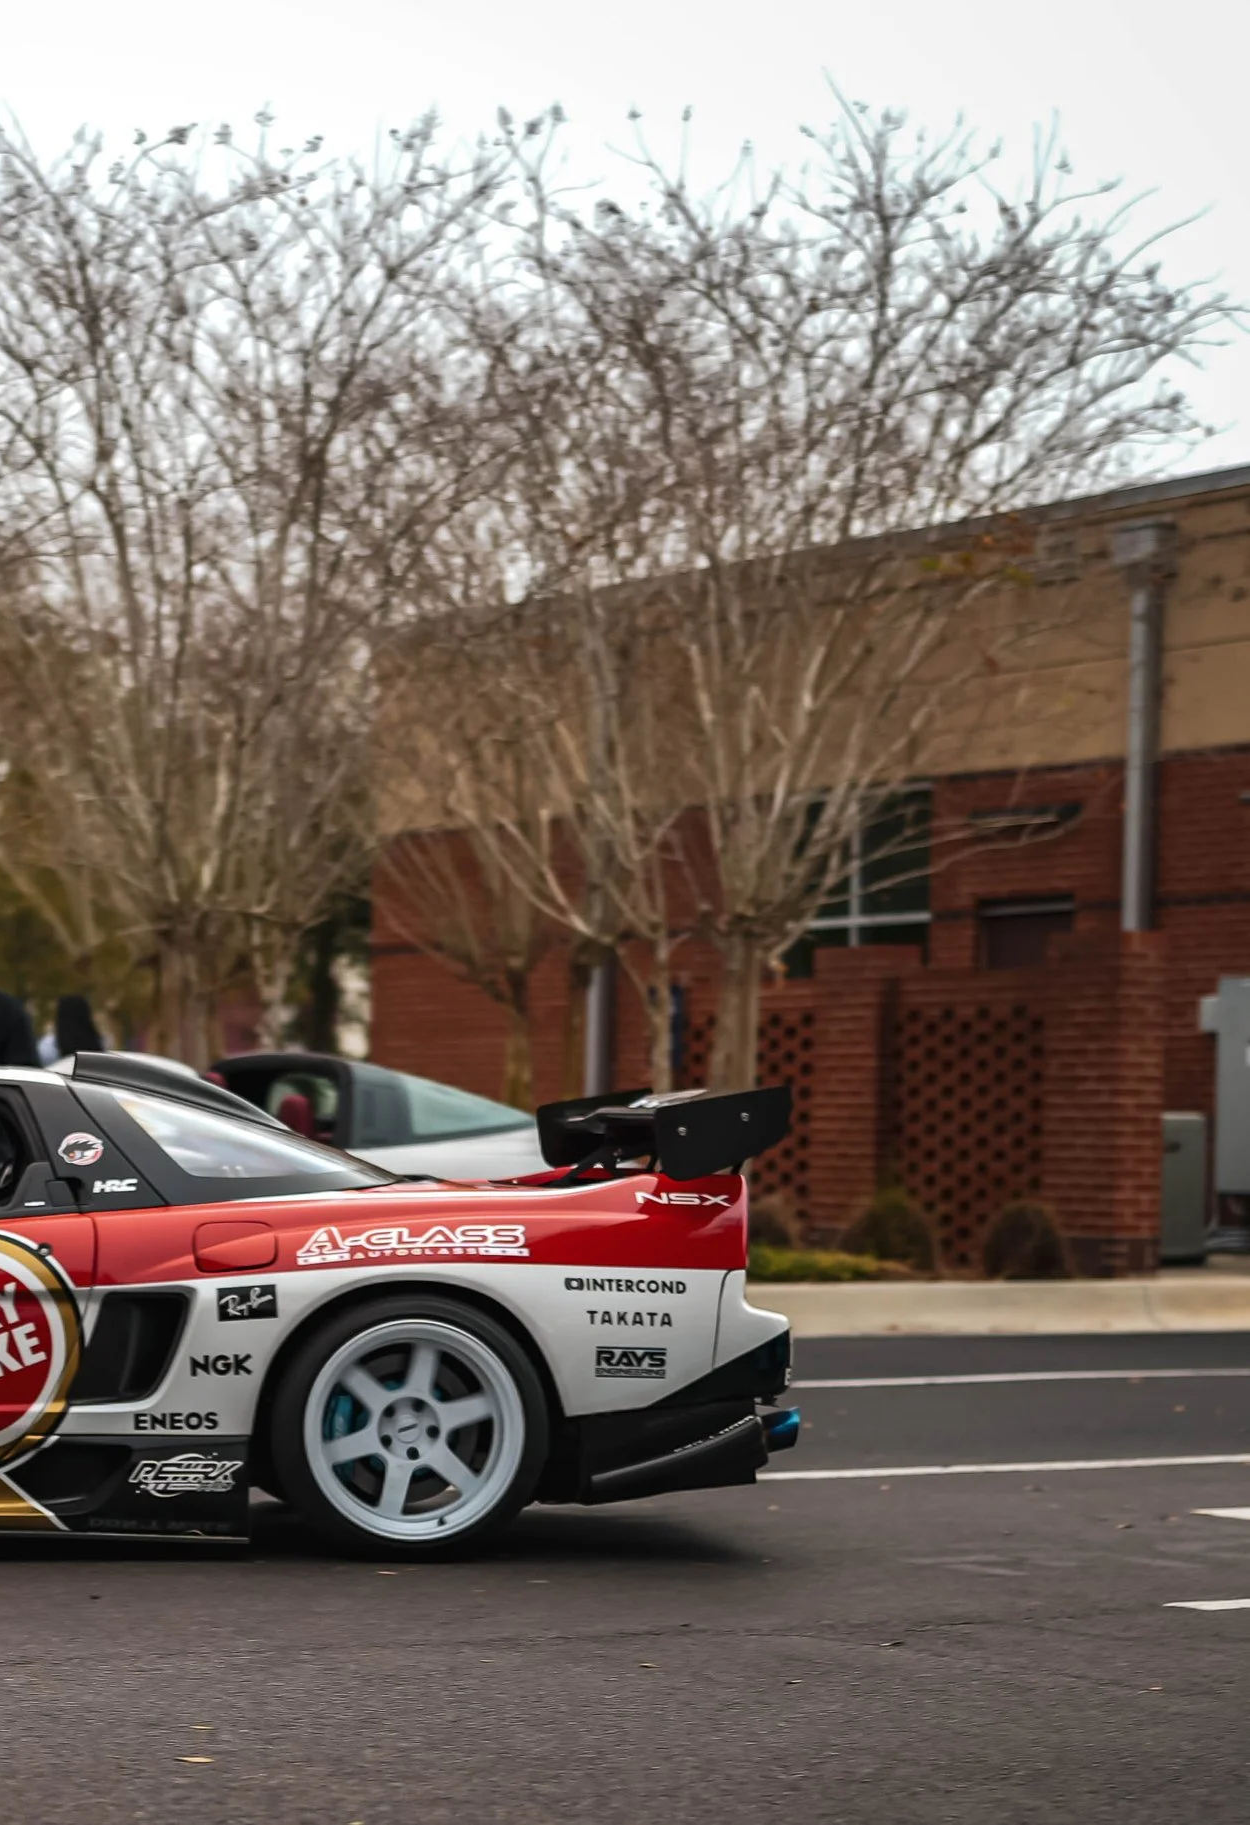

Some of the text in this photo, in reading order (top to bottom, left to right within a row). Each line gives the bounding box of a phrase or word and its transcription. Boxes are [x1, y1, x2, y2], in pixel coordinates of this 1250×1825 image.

[92, 1178, 138, 1193] HRC
[634, 1191, 733, 1207] NSX
[296, 1225, 525, 1256] A-CLASS
[585, 1278, 687, 1294] INTERCOND
[586, 1310, 672, 1327] TAKATA
[190, 1354, 253, 1376] NGK
[595, 1350, 667, 1368] RAYS
[133, 1412, 219, 1431] ENEOS
